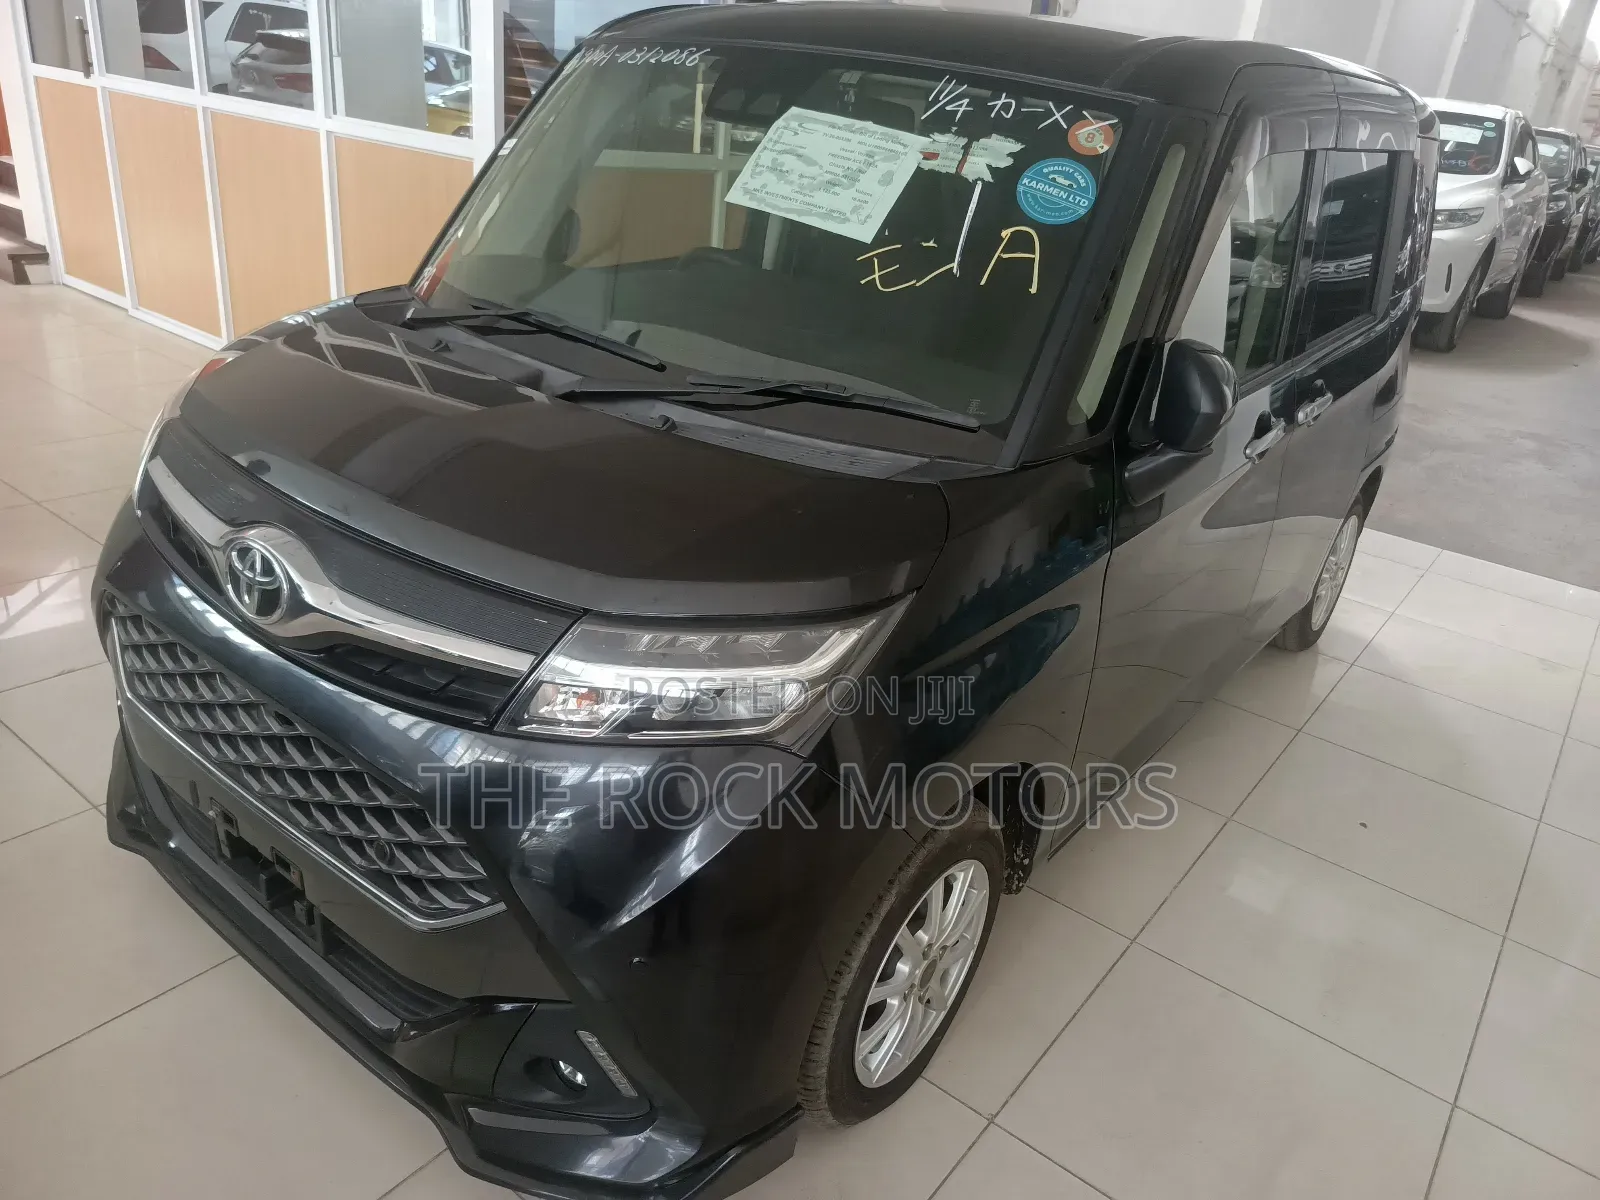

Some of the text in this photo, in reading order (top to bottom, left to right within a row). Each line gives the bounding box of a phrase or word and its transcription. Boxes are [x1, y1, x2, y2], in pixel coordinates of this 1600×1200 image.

[1085, 132, 1096, 143] 8
[1043, 165, 1087, 187] QUALITY CARS
[1022, 177, 1089, 207] KARMEN LTD
[799, 200, 826, 212] COMPANY
[825, 206, 847, 217] LIMITED
[979, 226, 1040, 294] A
